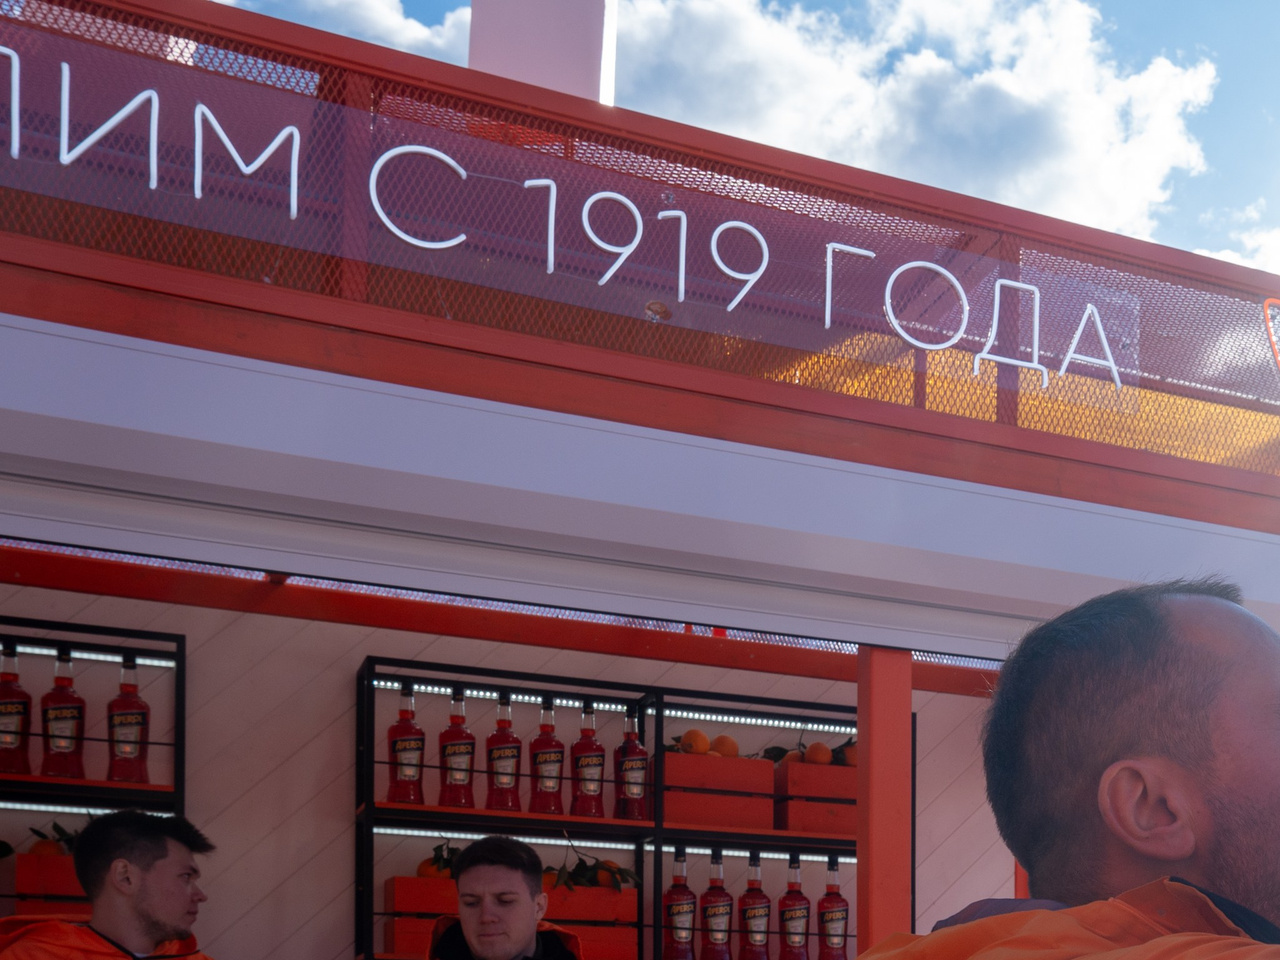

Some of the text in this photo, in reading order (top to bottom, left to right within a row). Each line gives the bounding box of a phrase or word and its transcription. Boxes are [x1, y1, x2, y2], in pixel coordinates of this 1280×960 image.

[369, 145, 467, 249] С
[524, 178, 769, 312] 1919
[825, 243, 1122, 390] ГОДА
[395, 740, 423, 751] APEROL
[445, 745, 473, 755] APEROL
[490, 749, 518, 760] APEROL
[536, 753, 563, 763] APEROL
[670, 904, 695, 914] APEROL
[706, 906, 731, 916] APEROL
[745, 908, 770, 918] APEROL
[783, 910, 808, 920] APEROL
[823, 911, 847, 921] APEROL
